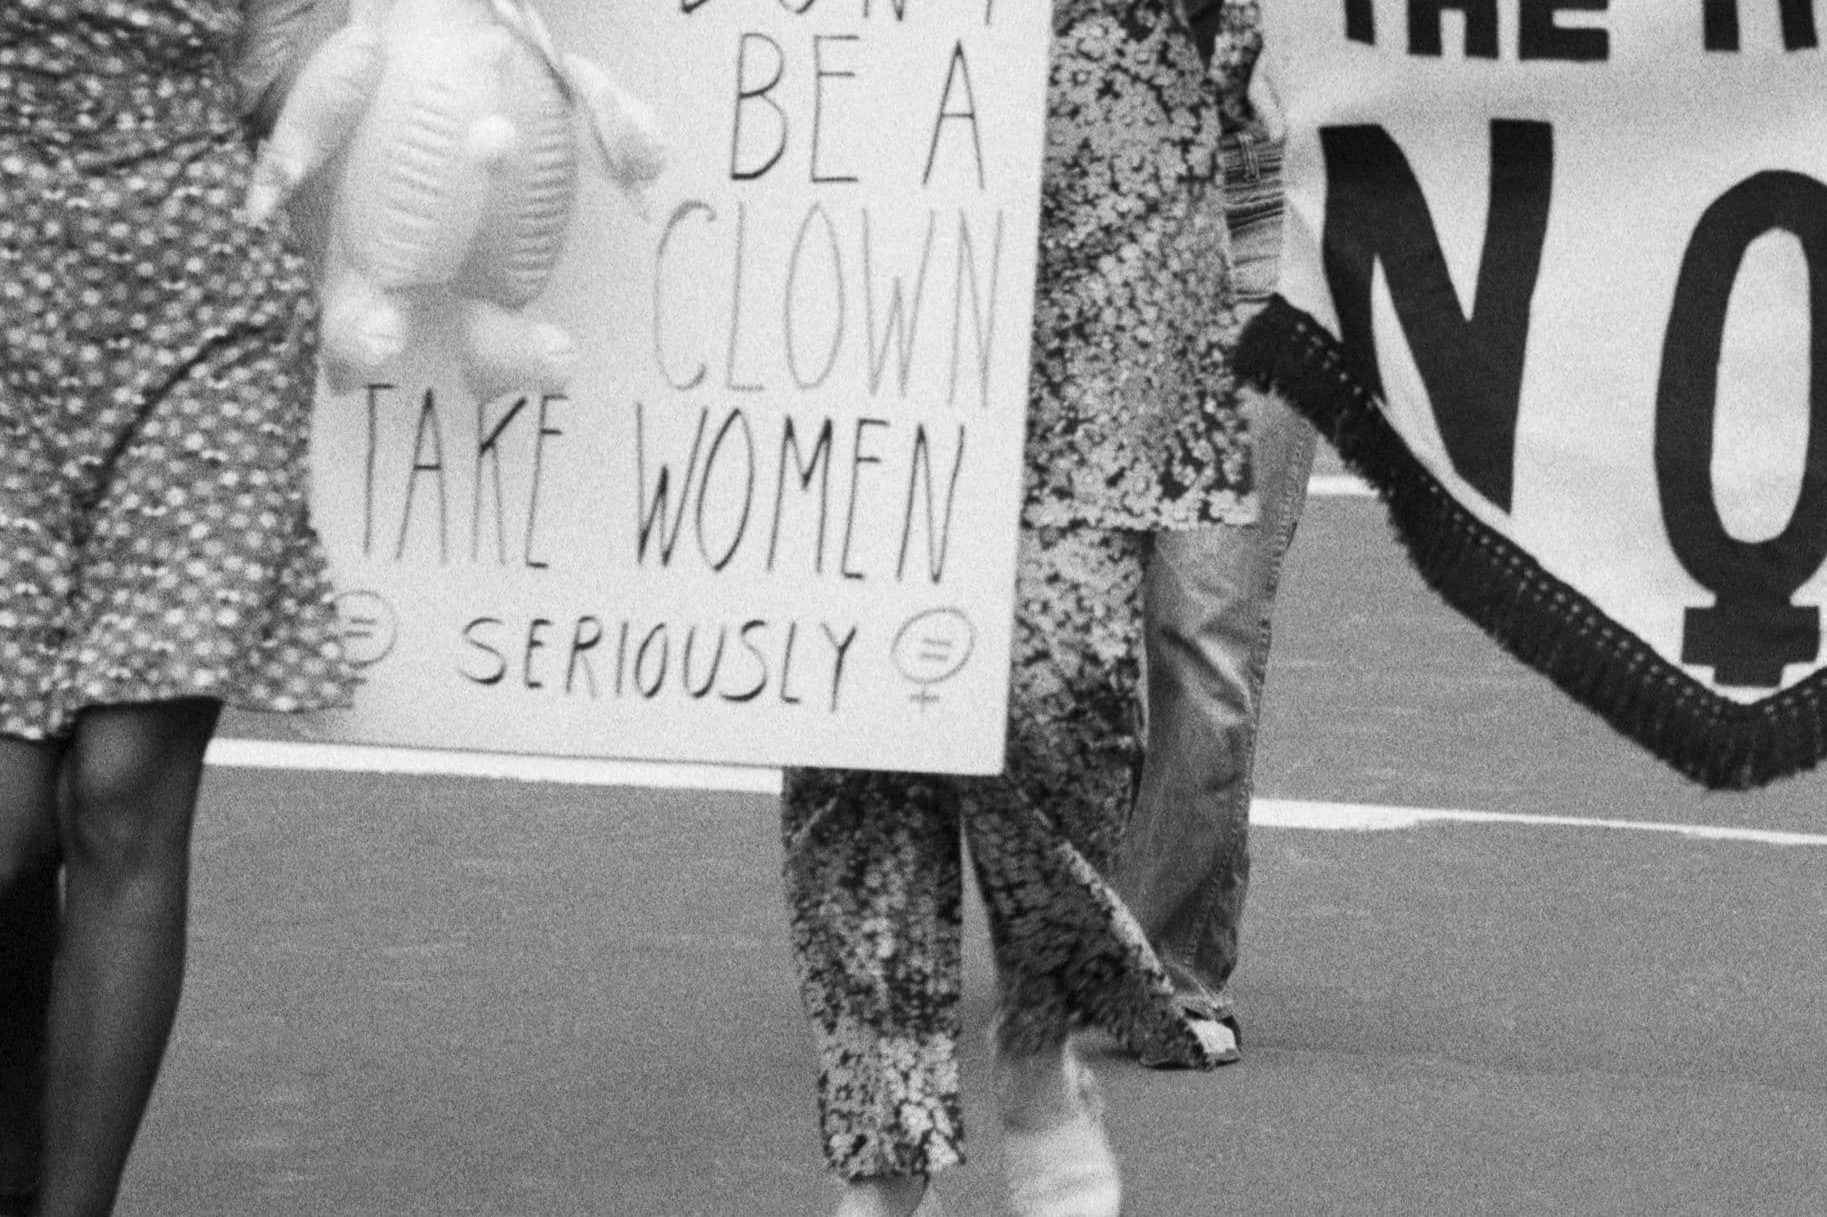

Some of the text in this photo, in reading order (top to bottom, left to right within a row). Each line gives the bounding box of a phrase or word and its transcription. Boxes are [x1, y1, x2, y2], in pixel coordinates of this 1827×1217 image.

[729, 33, 985, 191] BE A
[652, 200, 1003, 409] CLOWN
[361, 382, 966, 583] TAKE WOMEN
[458, 614, 857, 713] SERIOUSLY
